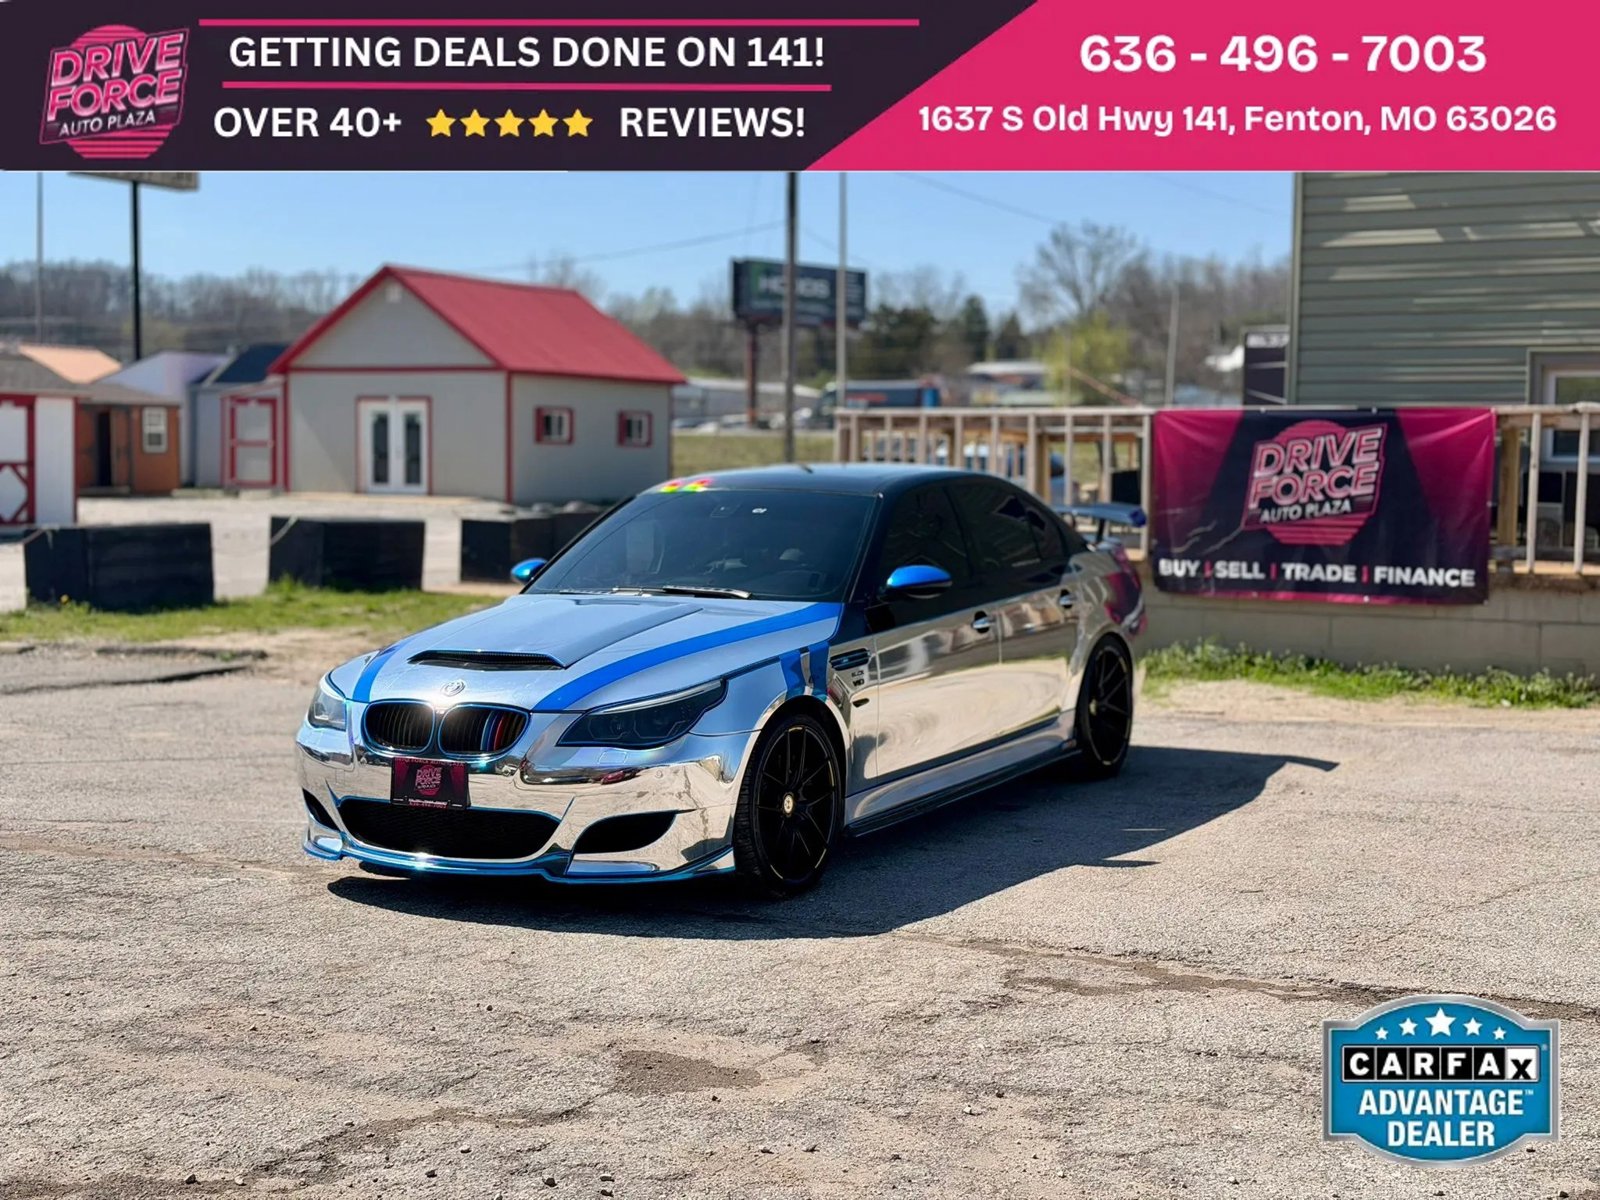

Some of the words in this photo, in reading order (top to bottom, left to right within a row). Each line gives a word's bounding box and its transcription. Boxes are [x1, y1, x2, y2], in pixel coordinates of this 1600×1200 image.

[1253, 427, 1383, 477] DRIVE
[1249, 461, 1380, 509] FORCE
[1260, 506, 1302, 523] AUTO
[1305, 500, 1351, 519] PLAZA
[1158, 558, 1200, 578] BUY
[1214, 560, 1265, 580] SELL
[1281, 562, 1356, 583] TRADE
[1373, 565, 1476, 588] FINANCE
[416, 767, 442, 779] DRIVE
